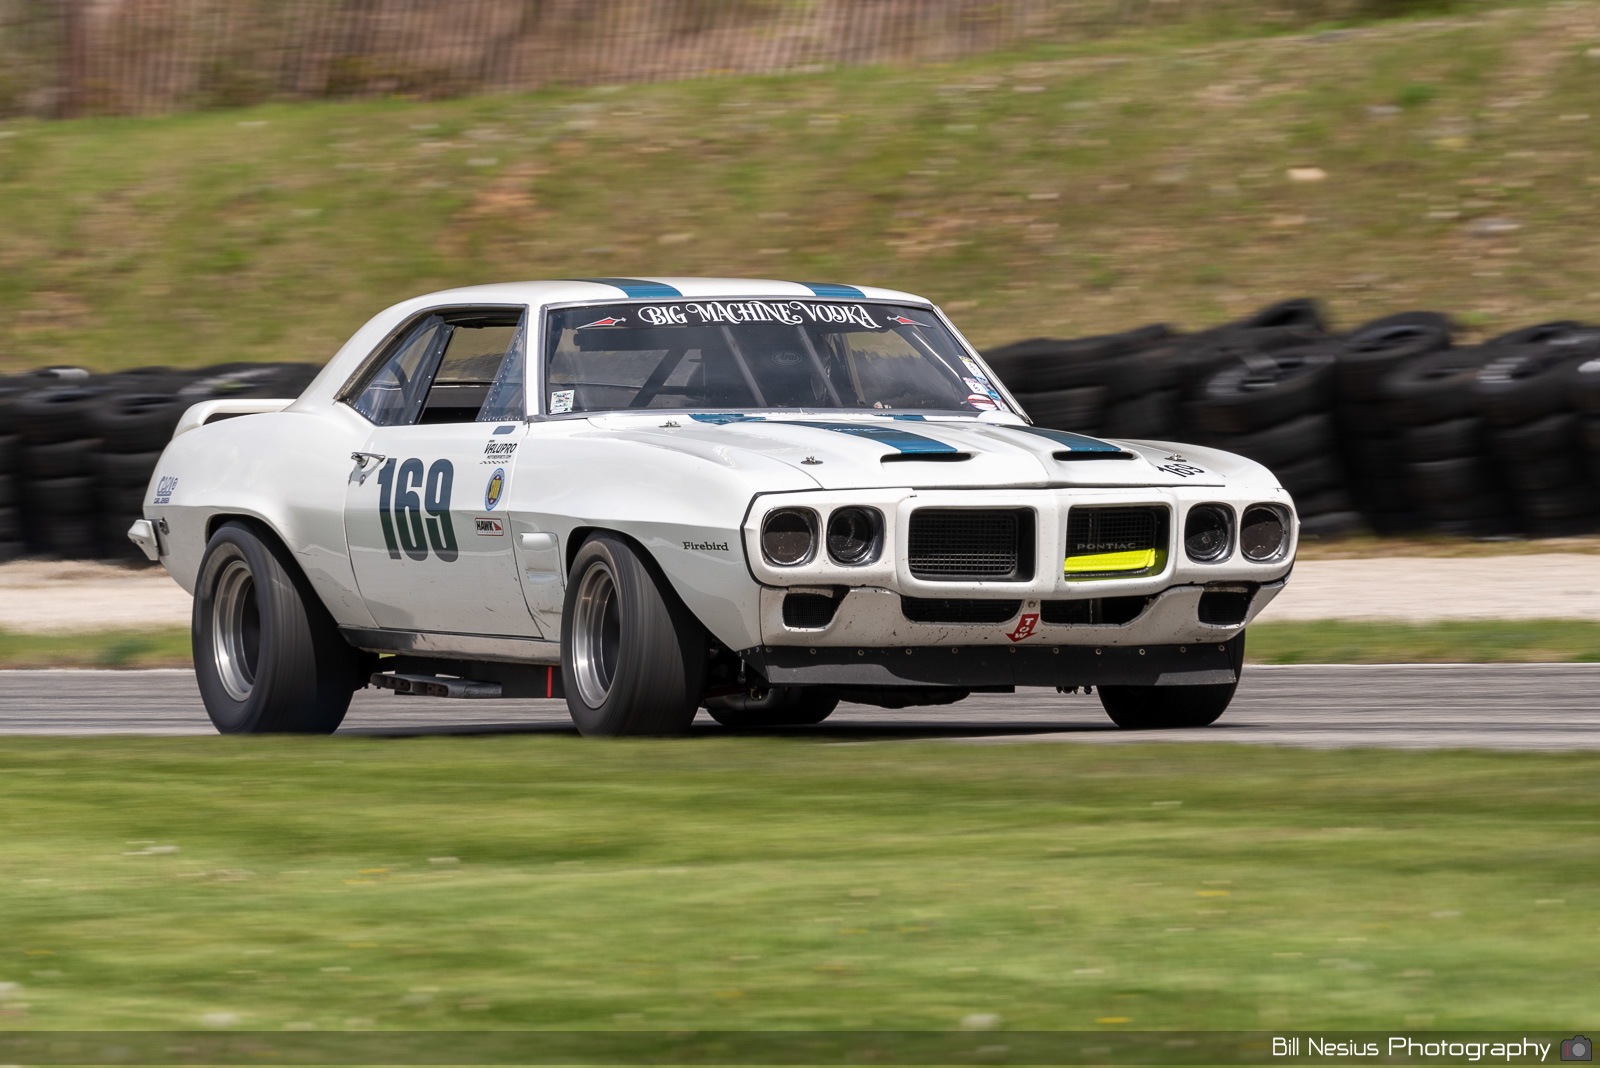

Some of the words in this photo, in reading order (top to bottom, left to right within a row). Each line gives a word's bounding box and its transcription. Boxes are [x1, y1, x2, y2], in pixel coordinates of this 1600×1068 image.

[638, 306, 688, 326] BIG
[685, 301, 804, 326] MACHINE
[790, 301, 882, 329] VODKA
[484, 443, 518, 455] VALUPRO
[1156, 463, 1205, 478] 169
[377, 457, 459, 563] 169
[475, 520, 494, 532] HAWK
[682, 541, 729, 552] Firebird
[1076, 542, 1137, 550] PONTIAC
